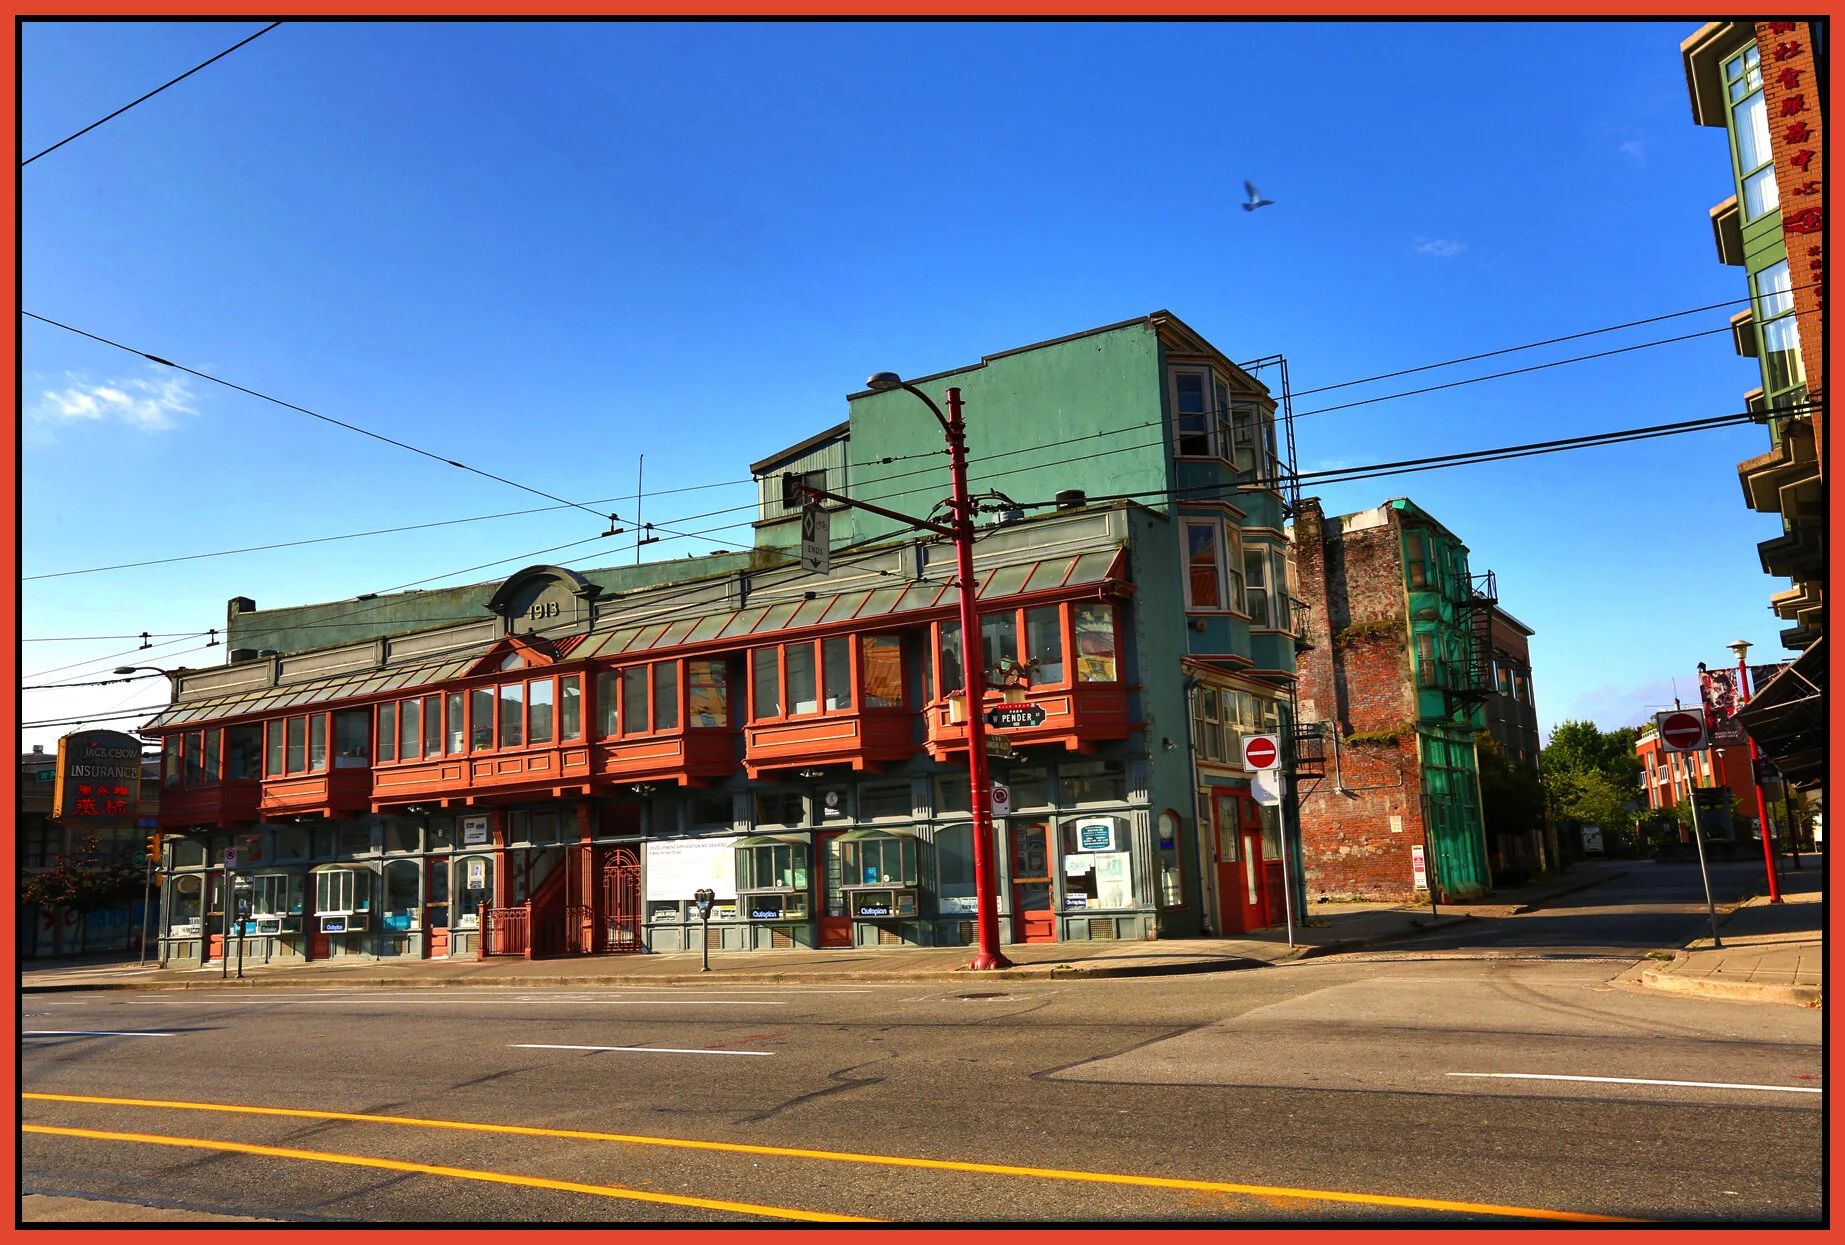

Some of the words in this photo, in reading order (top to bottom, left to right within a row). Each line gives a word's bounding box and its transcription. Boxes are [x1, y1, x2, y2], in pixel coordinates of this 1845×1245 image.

[807, 545, 824, 556] ENDS
[528, 601, 560, 621] 1913
[992, 715, 998, 723] W
[1001, 712, 1032, 723] PENDER
[83, 746, 107, 759] JACK
[108, 747, 138, 759] CHOW
[70, 764, 138, 779] INSURANCE
[437, 829, 443, 837] 8
